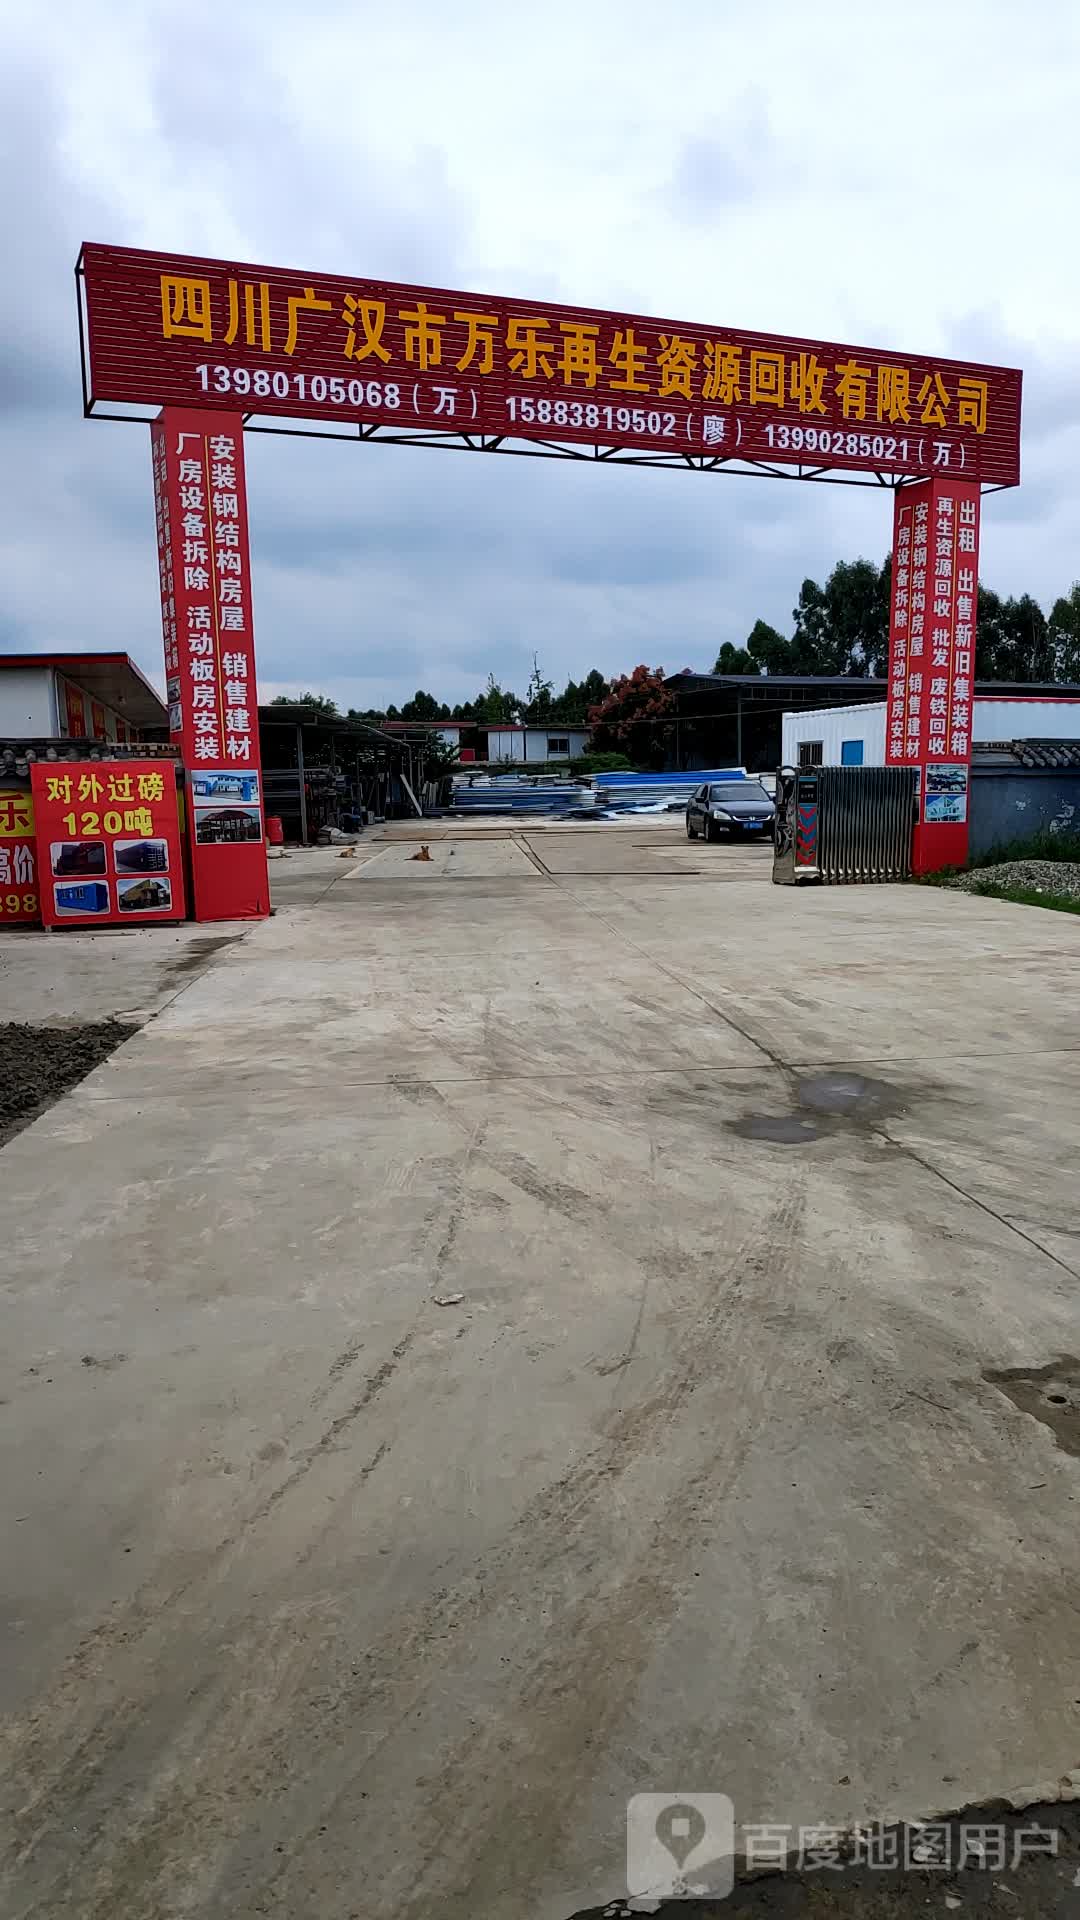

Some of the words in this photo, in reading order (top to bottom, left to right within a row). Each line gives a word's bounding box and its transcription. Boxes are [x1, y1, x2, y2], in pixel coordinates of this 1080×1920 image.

[160, 275, 987, 434] 四川广汉市万乐再生资源回收有限公司
[175, 432, 210, 591] 厂房设备拆除
[209, 435, 246, 631] 安装钢结构房屋
[894, 506, 912, 629] 厂房设备拆除
[933, 496, 954, 618] 再生资源回收
[958, 500, 976, 553] 出租
[909, 502, 929, 657] 安装钢结构房屋
[186, 605, 220, 760] 活动板房安装
[222, 652, 252, 761] 销售建材
[889, 639, 907, 759] 活动板房安装
[931, 628, 950, 667] 批发
[951, 568, 974, 756] 出售新旧集装箱
[906, 673, 923, 759] 销售建材
[928, 678, 948, 756] 废铁回收
[46, 772, 165, 804] 对外过磅
[63, 806, 153, 836] 120吨
